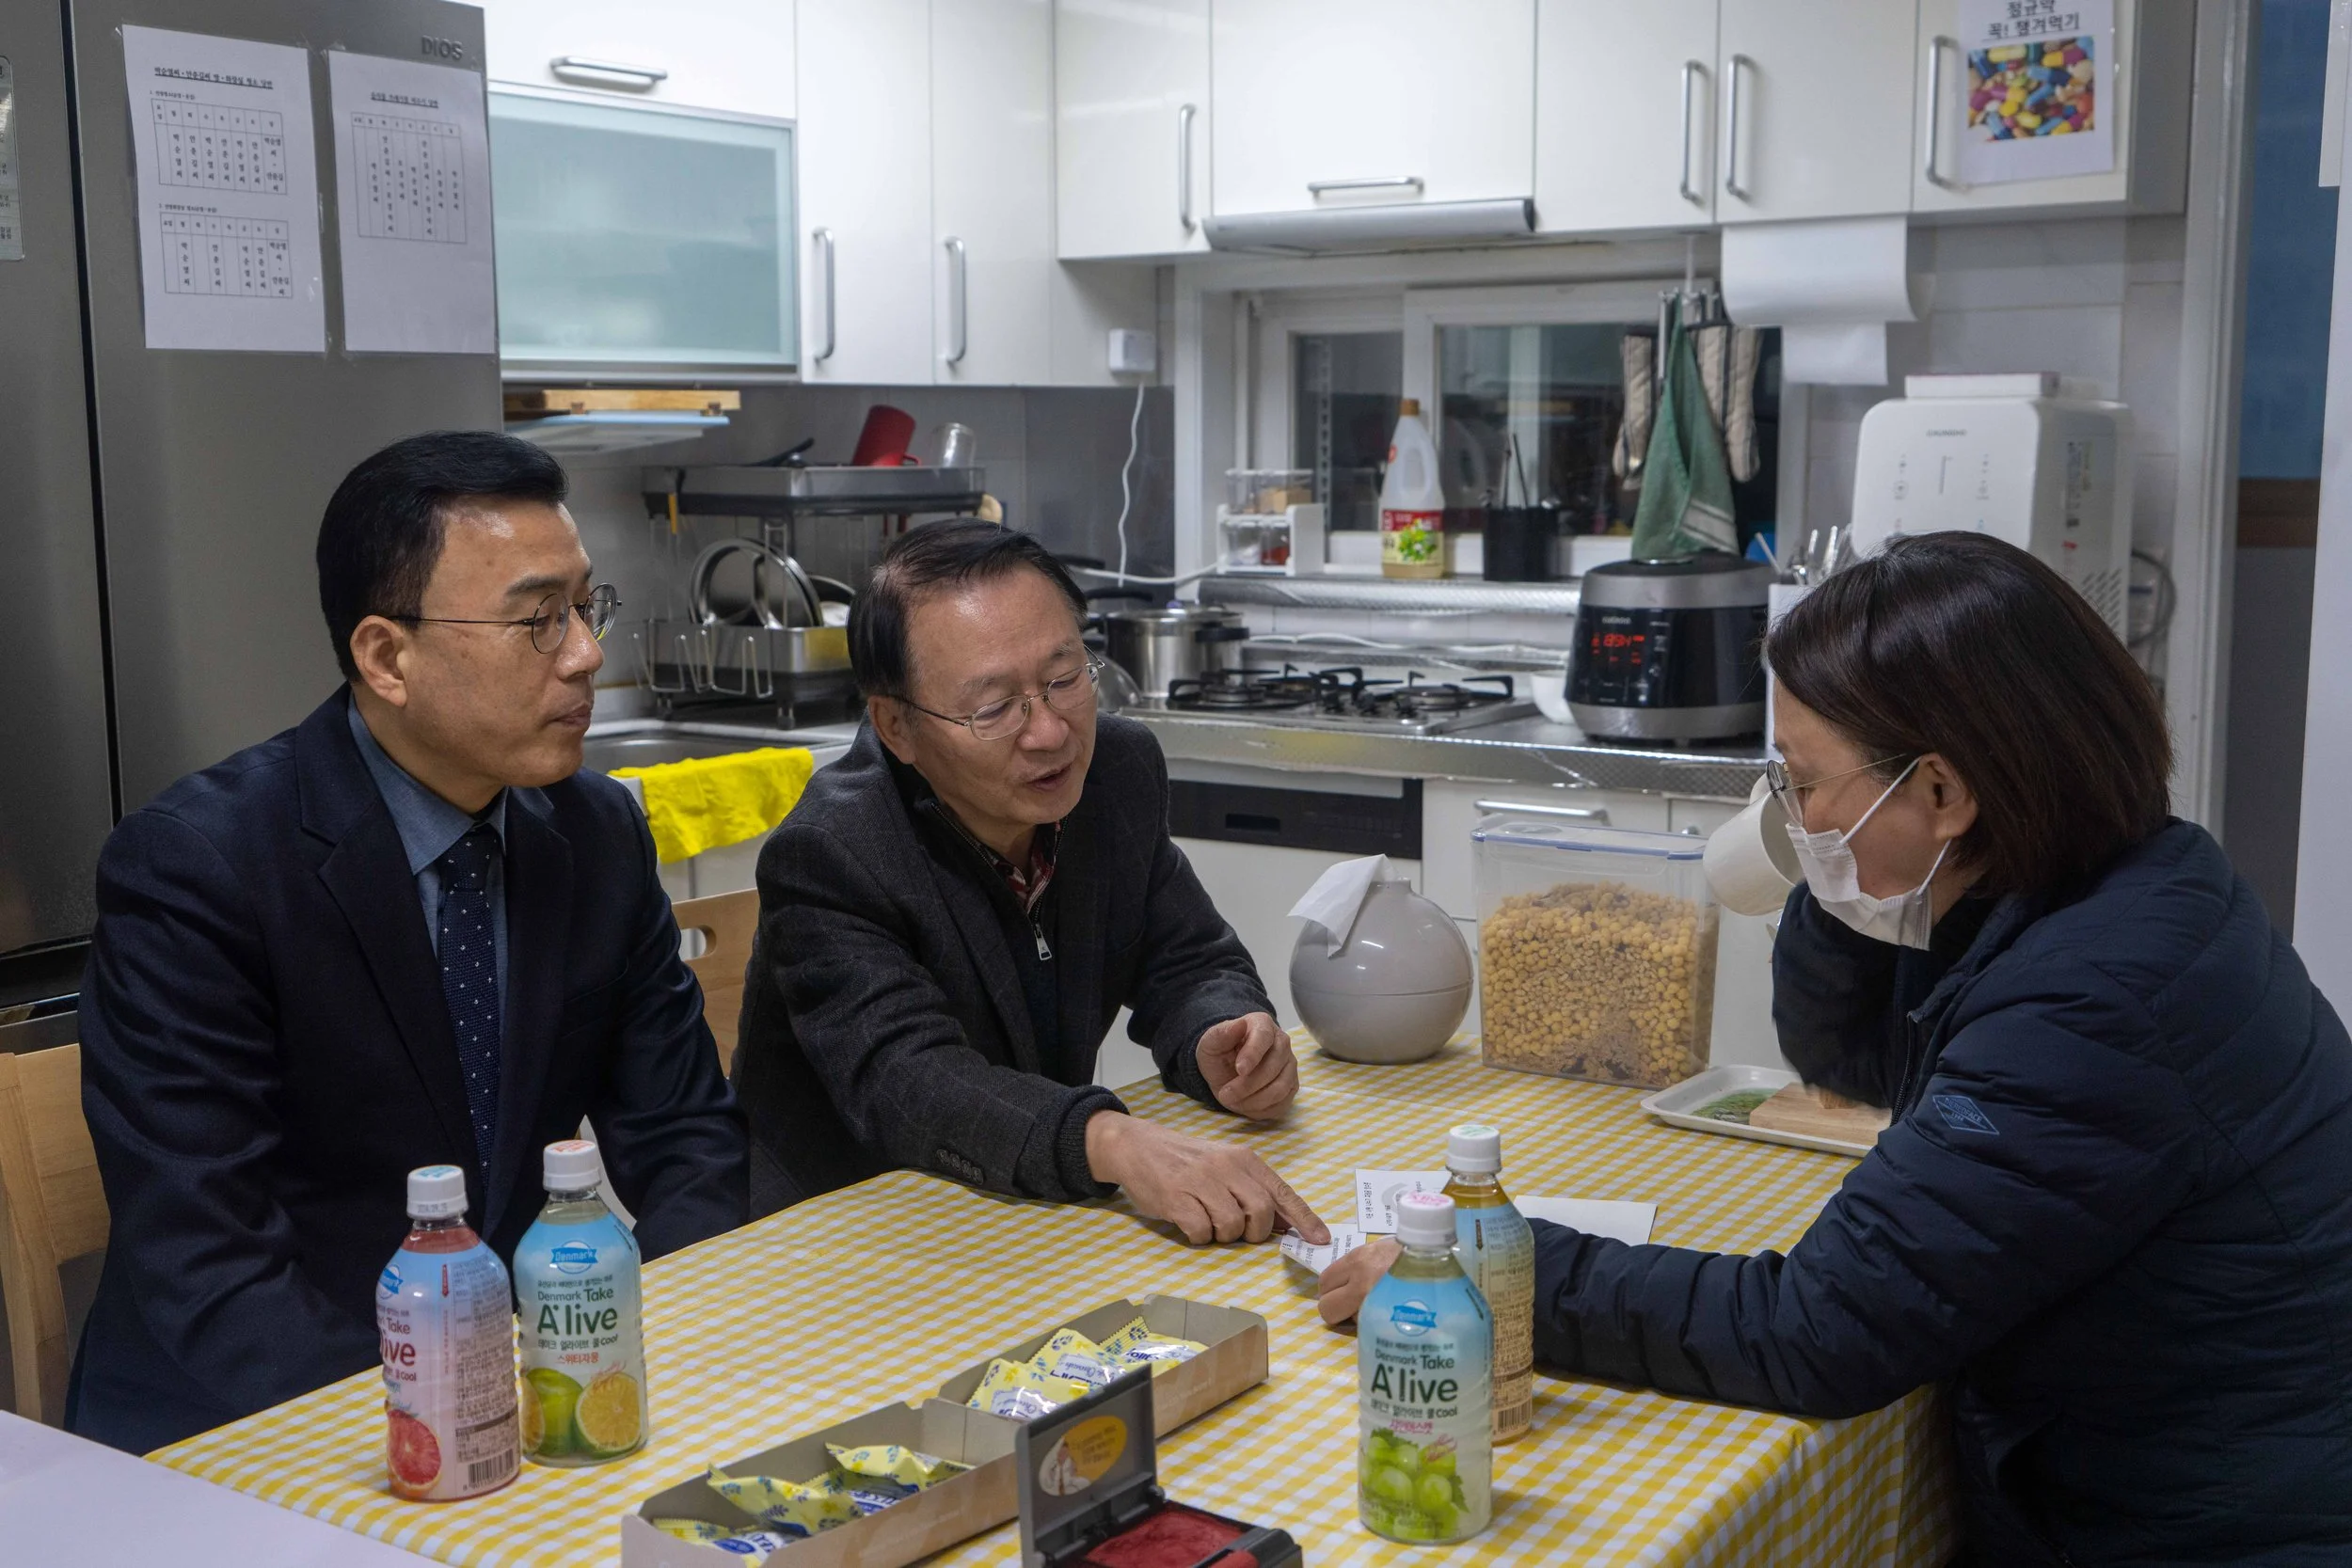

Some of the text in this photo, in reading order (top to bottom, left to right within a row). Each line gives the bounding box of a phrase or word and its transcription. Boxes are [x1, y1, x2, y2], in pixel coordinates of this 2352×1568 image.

[421, 36, 463, 60] DIOS
[537, 1287, 614, 1303] Denmark Take
[387, 1317, 411, 1335] Take
[1375, 1349, 1455, 1370] Denmark Take
